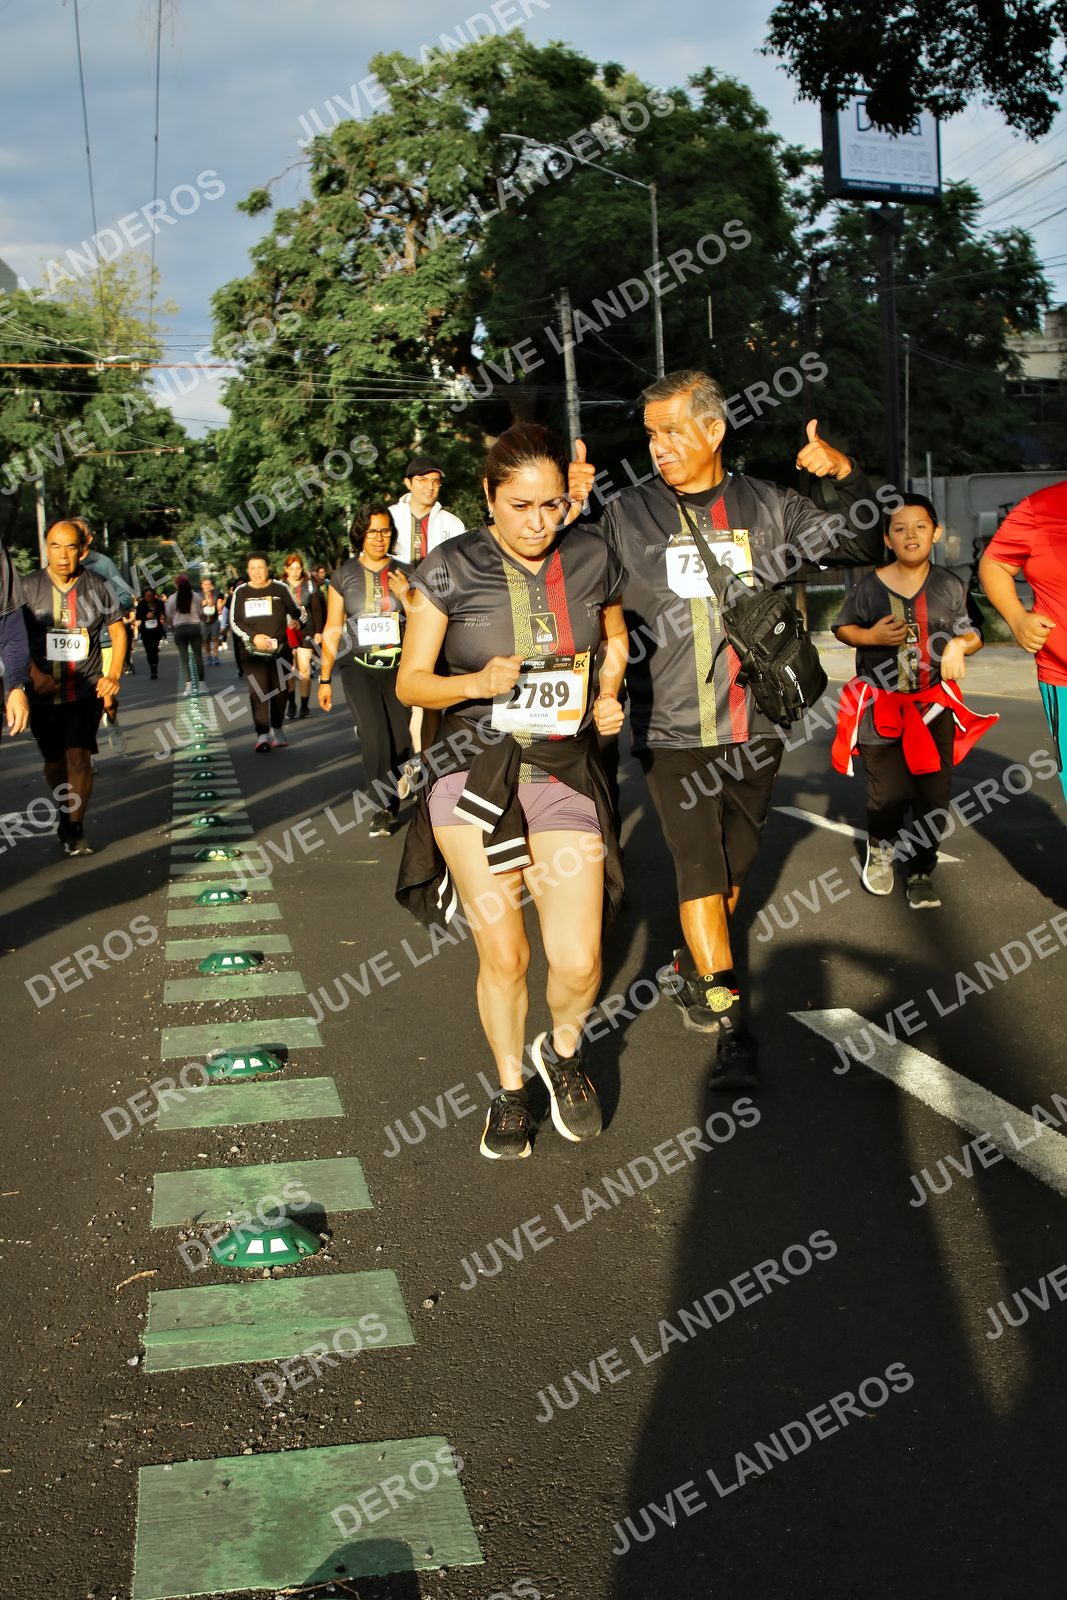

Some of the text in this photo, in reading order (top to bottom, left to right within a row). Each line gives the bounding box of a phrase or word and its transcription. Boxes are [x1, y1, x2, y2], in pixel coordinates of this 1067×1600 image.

[678, 550, 734, 574] 736
[364, 622, 390, 633] 4095
[52, 637, 80, 649] 1960
[506, 680, 570, 709] 2789
